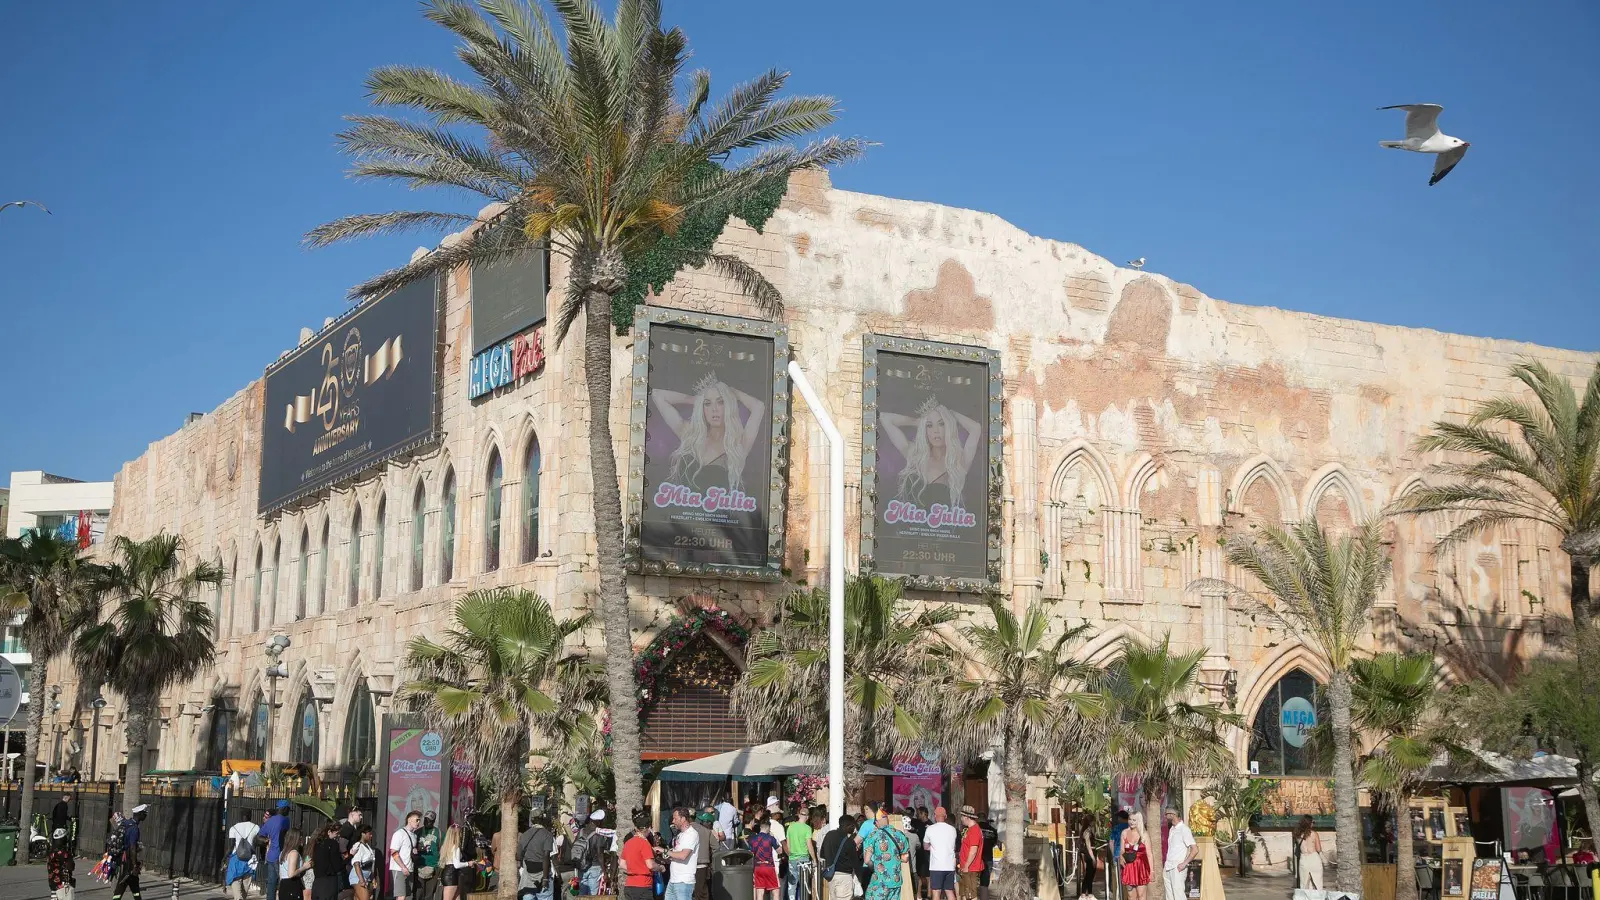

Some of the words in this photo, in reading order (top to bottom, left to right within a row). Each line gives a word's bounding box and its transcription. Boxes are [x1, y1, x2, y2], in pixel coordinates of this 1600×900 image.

[469, 343, 512, 399] MEGA
[312, 418, 360, 456] ANNIVERSARY
[654, 482, 702, 508] Mia
[702, 486, 757, 512] Julia
[884, 499, 927, 524] Mia
[927, 503, 976, 528] Julia
[674, 535, 706, 547] 22:30
[709, 538, 733, 549] UHR
[902, 550, 931, 560] 22:30
[934, 551, 956, 562] UHR
[1283, 710, 1315, 725] MEGA
[394, 731, 412, 746] HEUTE
[391, 758, 416, 773] Mia
[415, 758, 441, 773] Julia
[1285, 780, 1320, 797] MEGA
[1471, 891, 1497, 899] PAELLA
